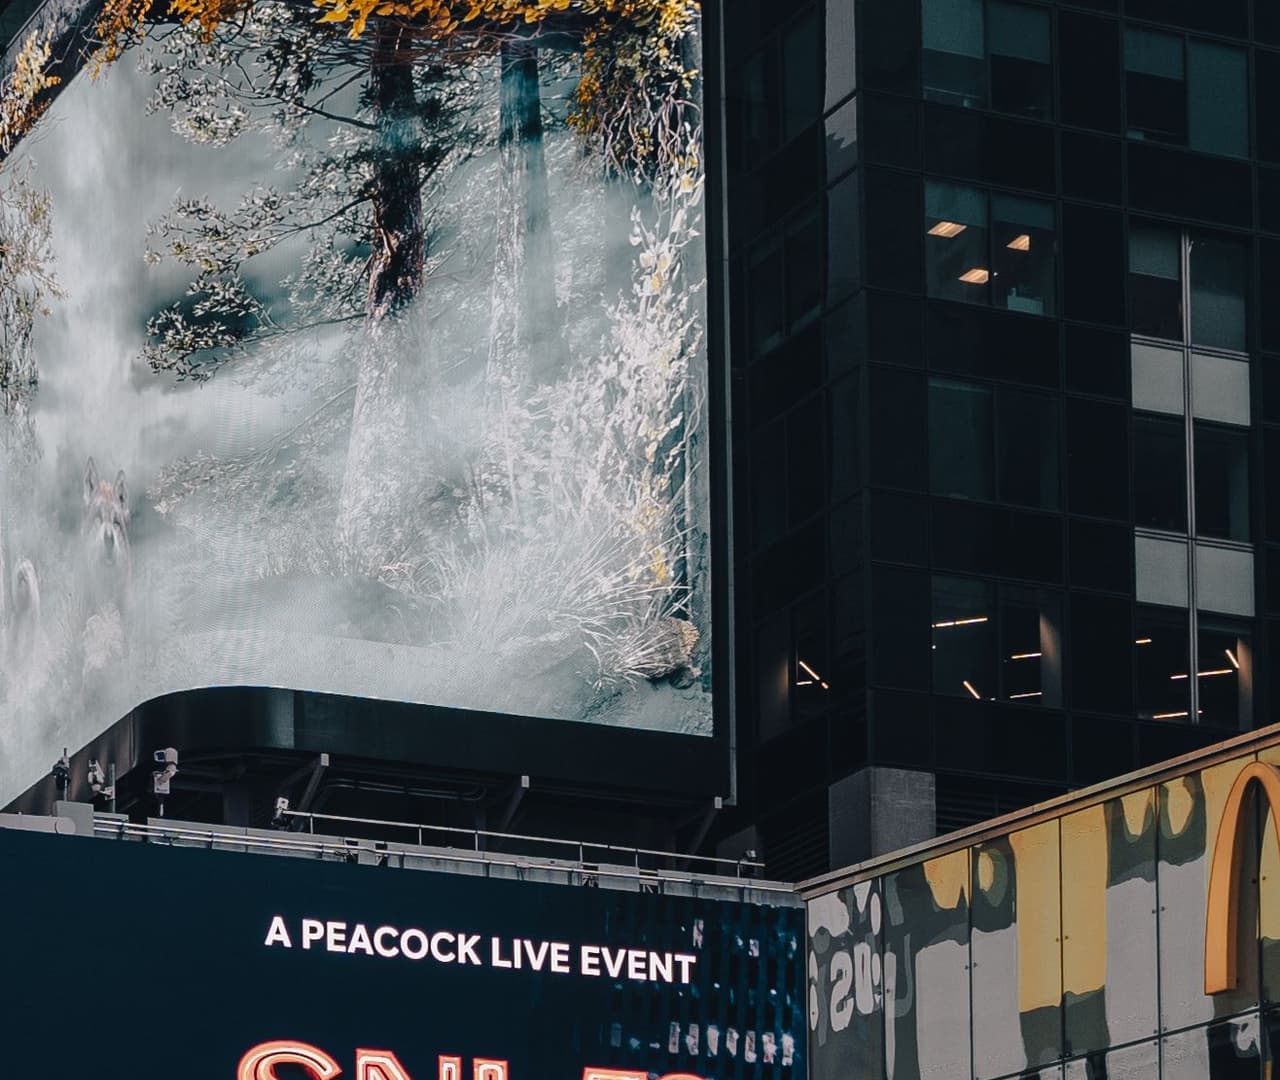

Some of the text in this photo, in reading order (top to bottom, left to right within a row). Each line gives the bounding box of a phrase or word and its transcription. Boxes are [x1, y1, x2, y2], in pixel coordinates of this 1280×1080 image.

[264, 916, 697, 985] A PEACOCK LIVE EVENT
